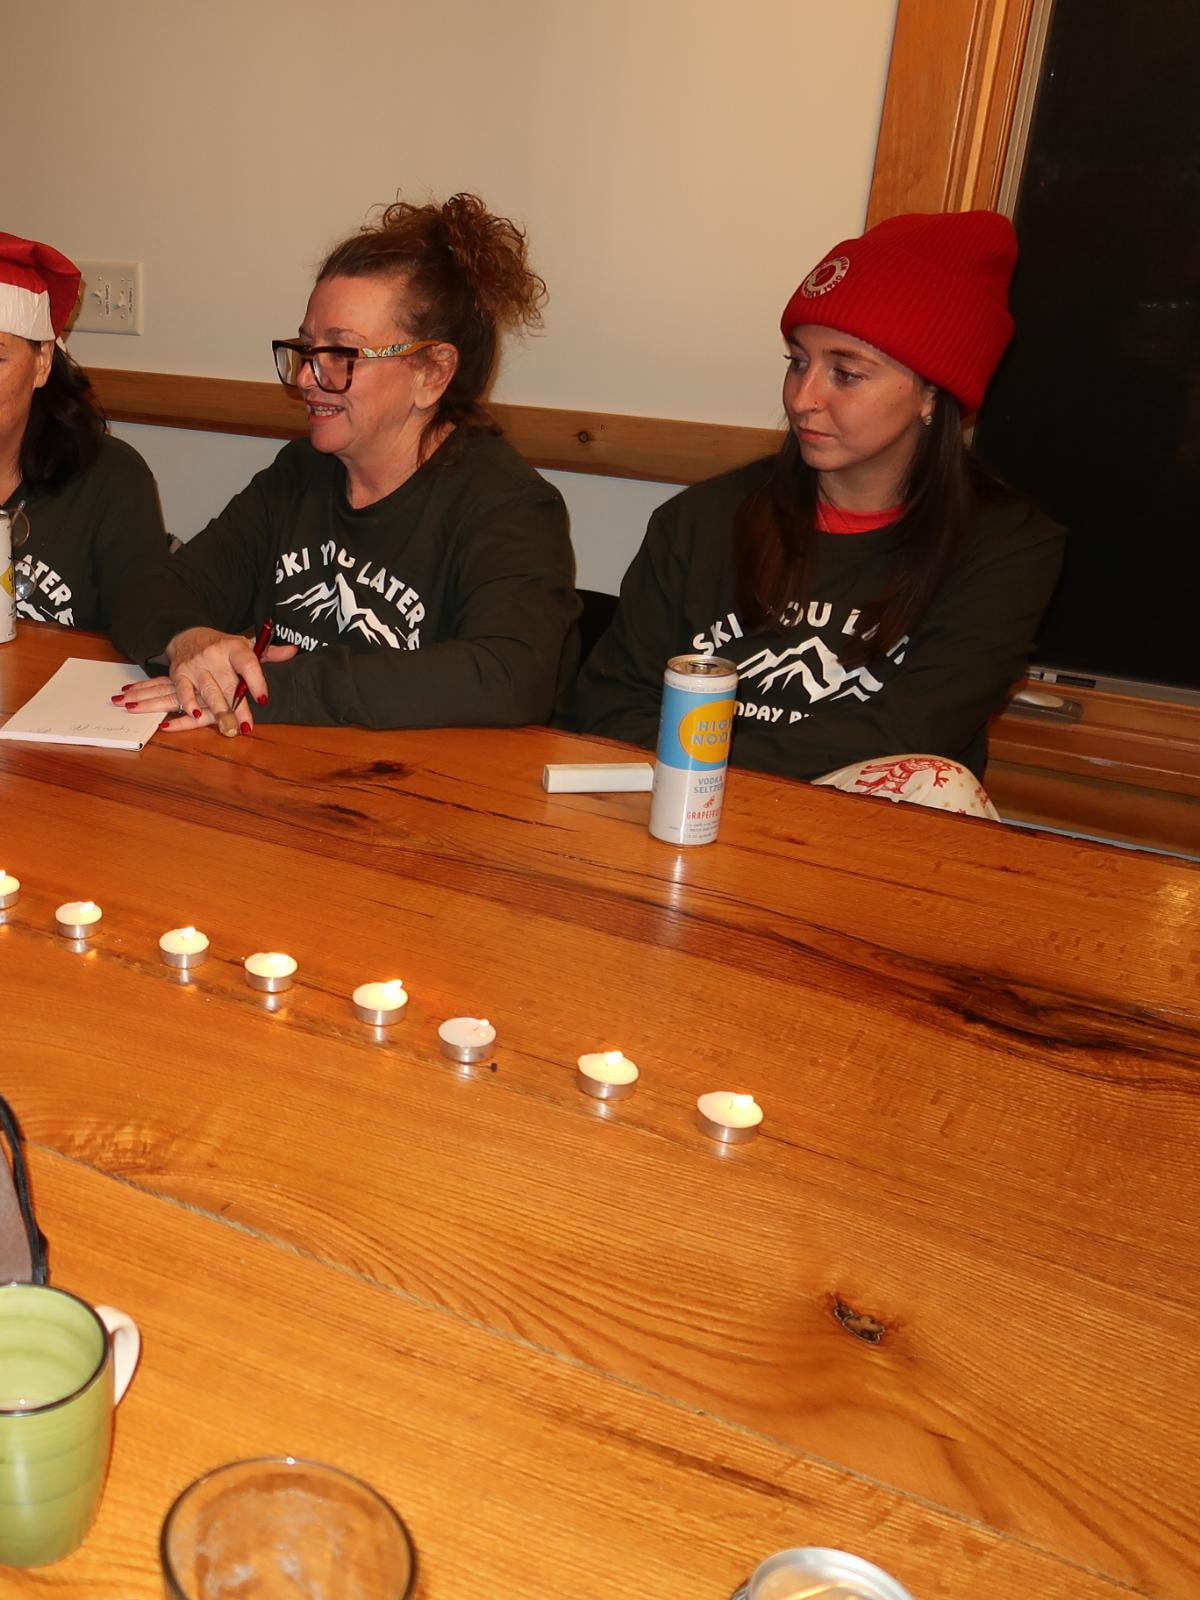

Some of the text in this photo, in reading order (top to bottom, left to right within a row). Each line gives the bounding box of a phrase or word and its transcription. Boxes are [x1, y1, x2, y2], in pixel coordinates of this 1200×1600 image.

[14, 554, 72, 606] ATER
[356, 561, 426, 629] LATER
[275, 624, 319, 652] SUNDAY
[692, 601, 833, 656] SKI OU
[734, 700, 784, 723] NDAY
[698, 719, 730, 732] HIG
[692, 732, 729, 745] NOO
[698, 775, 723, 785] VODKA
